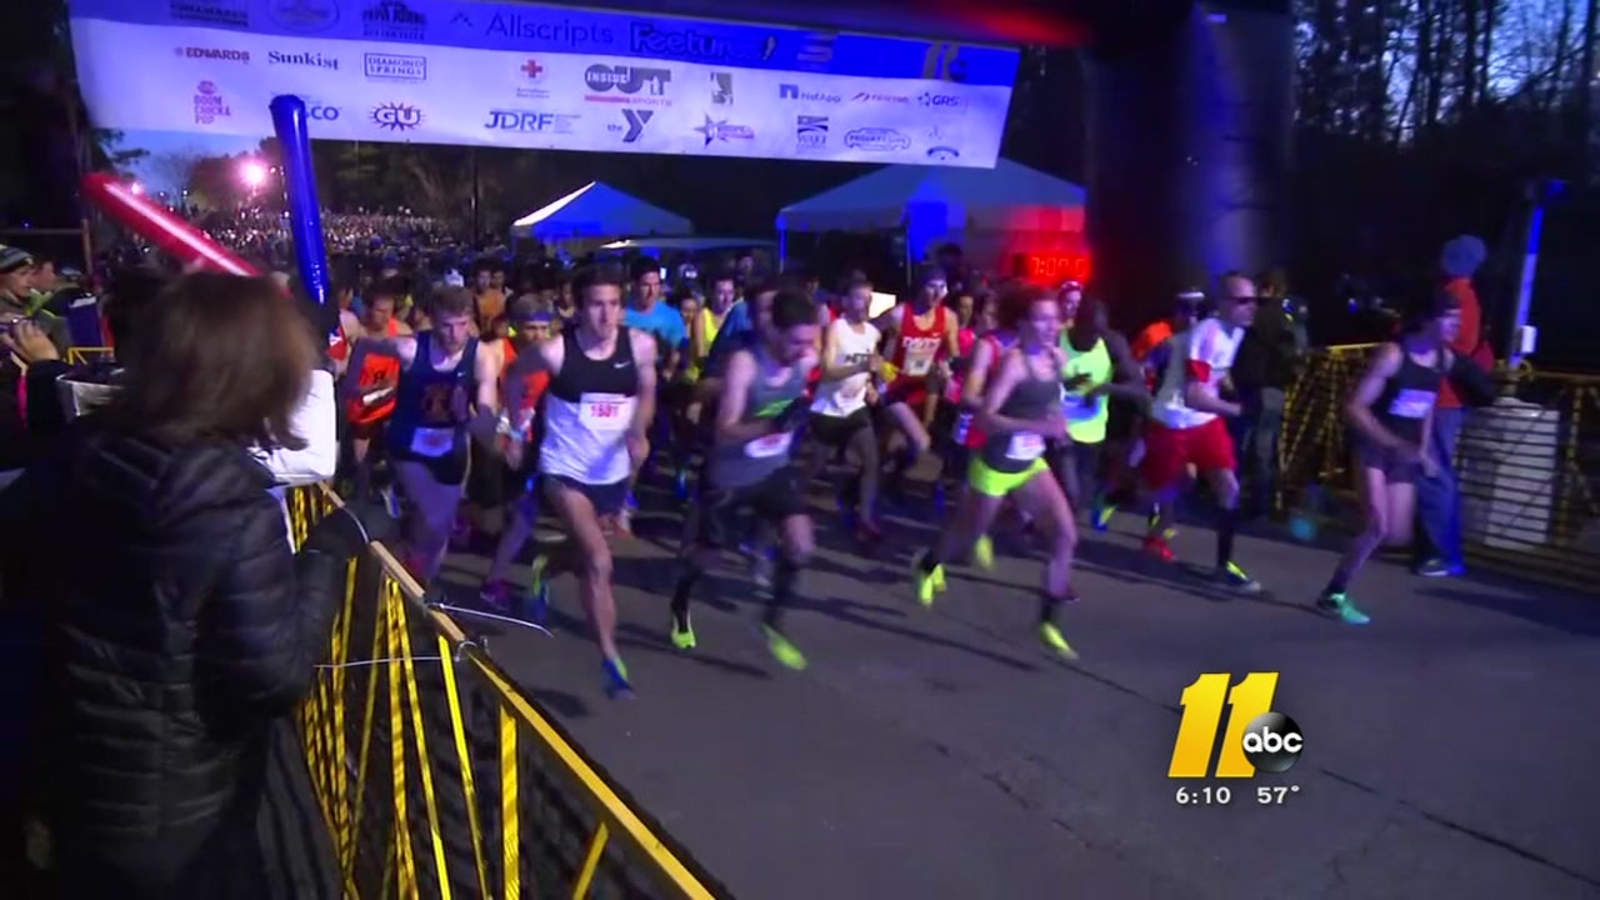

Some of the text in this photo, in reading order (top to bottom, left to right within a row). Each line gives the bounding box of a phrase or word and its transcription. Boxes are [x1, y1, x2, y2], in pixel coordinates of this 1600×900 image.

[485, 13, 614, 47] Allscripts
[186, 47, 250, 61] EDWARDS
[268, 51, 339, 71] Sunkist
[368, 57, 423, 67] DIAMOND
[369, 66, 422, 76] SPRINGS
[586, 71, 629, 83] INSIDE
[372, 109, 421, 125] GU
[484, 111, 554, 131] JDRF
